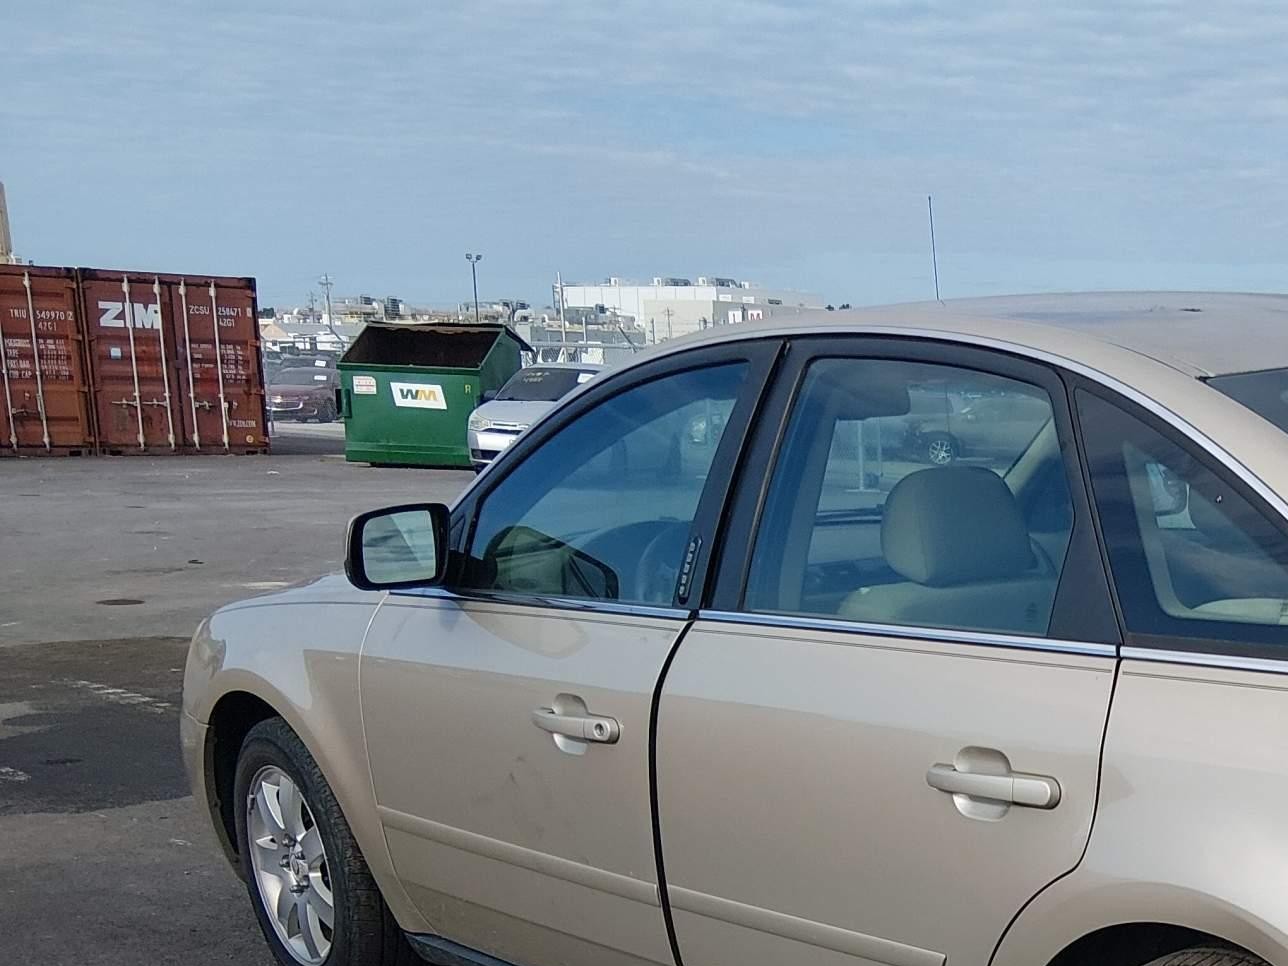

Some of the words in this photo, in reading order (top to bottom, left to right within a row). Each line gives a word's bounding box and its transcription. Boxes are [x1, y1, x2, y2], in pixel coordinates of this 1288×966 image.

[10, 308, 27, 319] TRIU
[36, 310, 65, 320] 549970
[98, 301, 161, 329] ZIM
[399, 388, 438, 401] WM
